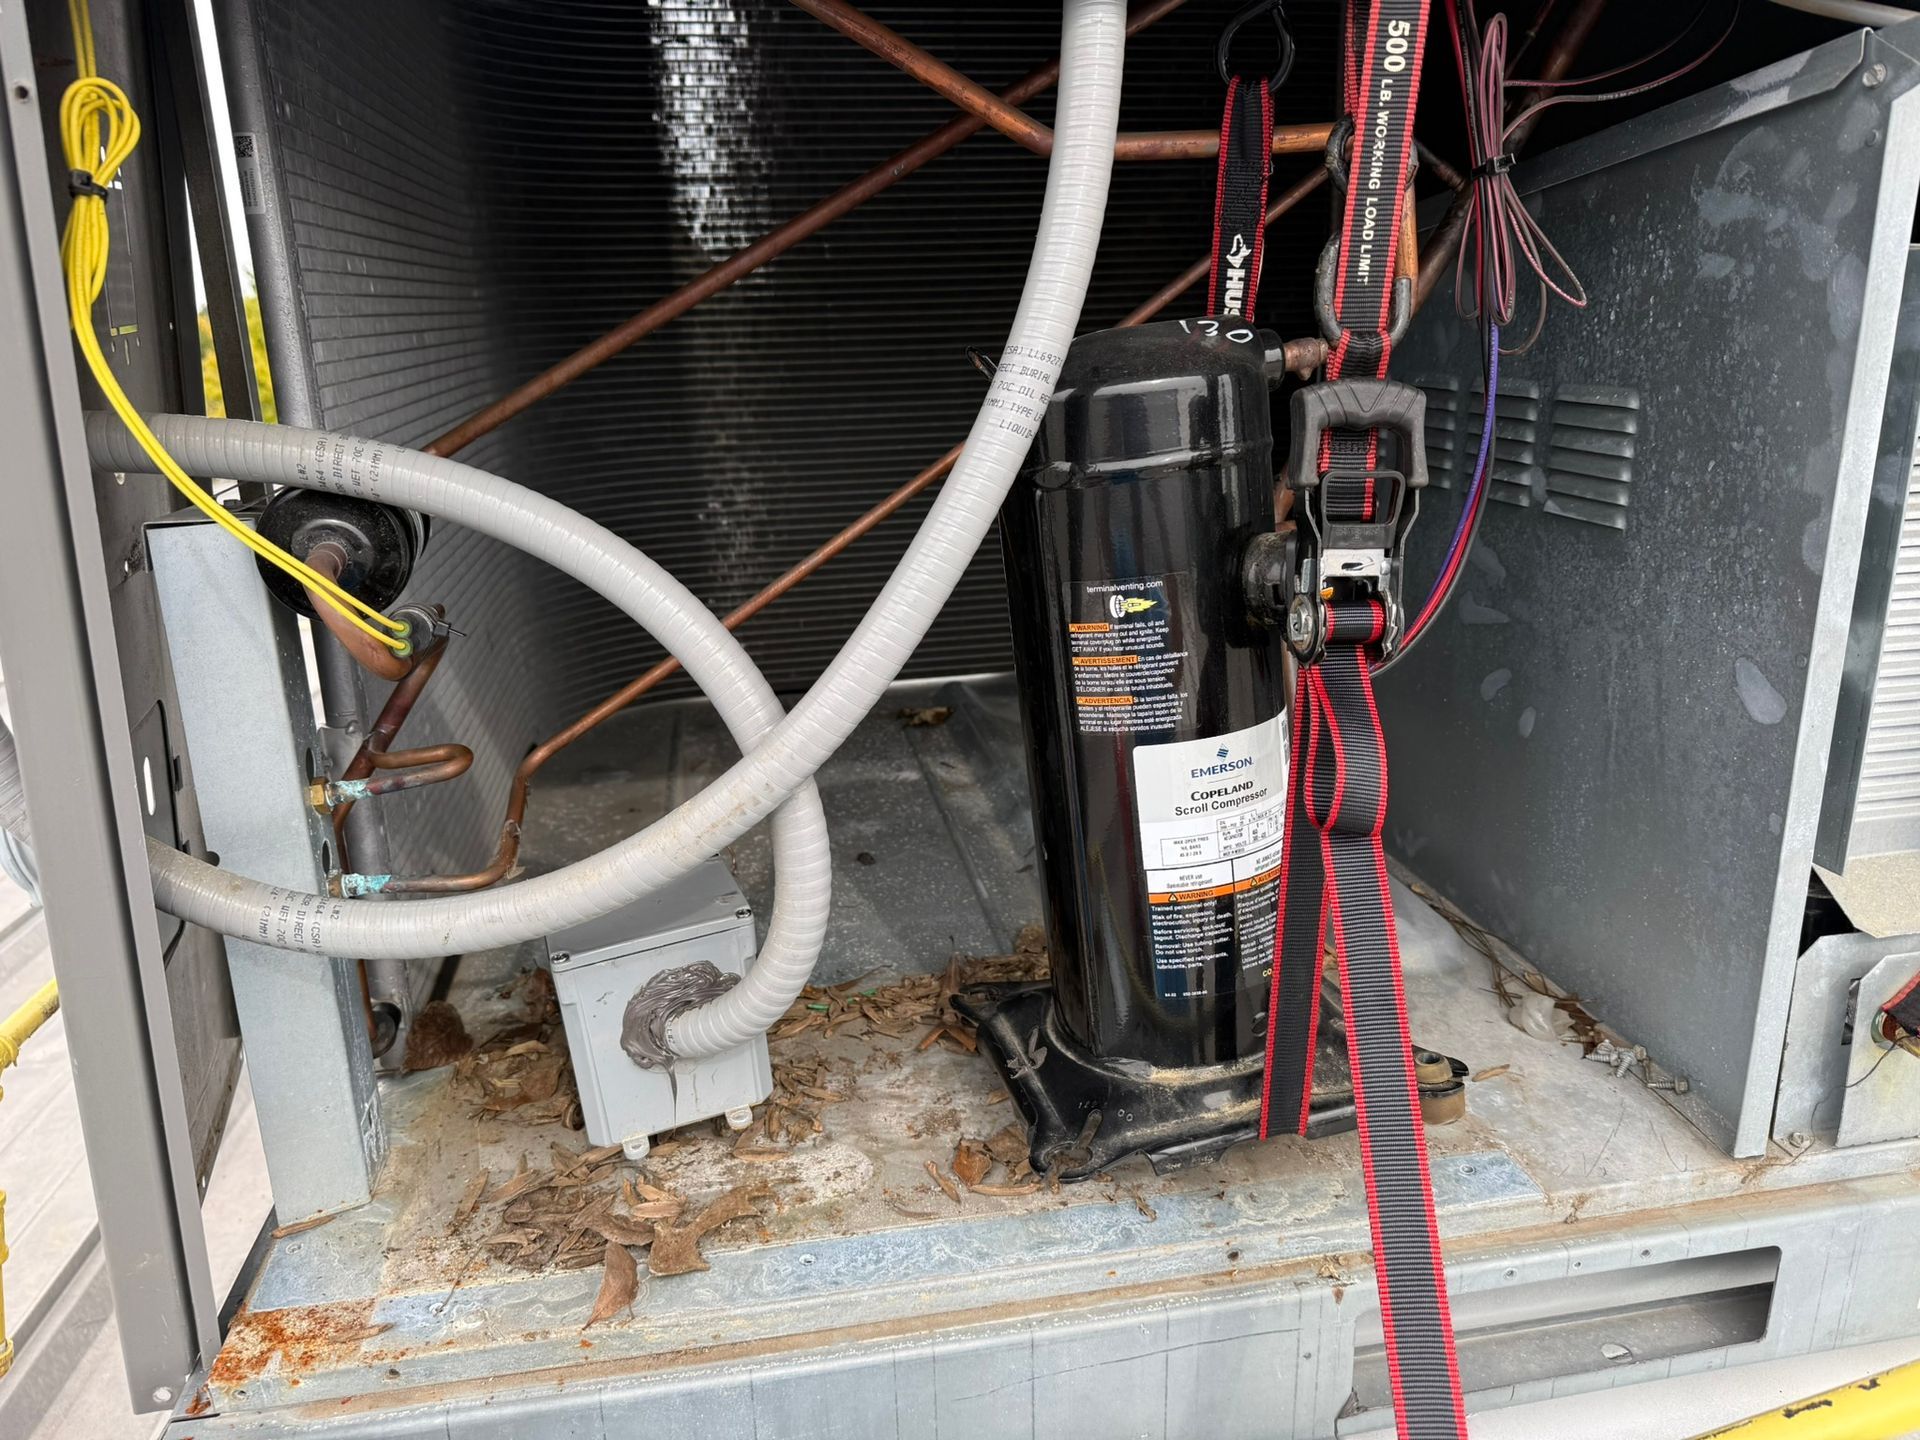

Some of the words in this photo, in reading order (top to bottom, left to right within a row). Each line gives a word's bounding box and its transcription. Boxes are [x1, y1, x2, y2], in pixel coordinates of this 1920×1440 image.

[1383, 20, 1410, 72] 500
[1379, 79, 1393, 107] LB.
[1368, 110, 1389, 190] WORKING
[1363, 197, 1378, 241] LOAD
[1357, 243, 1372, 285] LIMIT
[1020, 366, 1052, 384] BURIAL
[1018, 386, 1035, 399] OIL
[1010, 402, 1033, 417] TYPE
[333, 443, 345, 478] DIRECT
[351, 470, 360, 486] WET
[1087, 580, 1163, 593] terminalventing.com
[1191, 756, 1252, 779] EMERSON
[1175, 803, 1208, 816] Scroll
[1211, 788, 1267, 811] Compressor
[1191, 781, 1253, 801] COPELAND
[1180, 890, 1213, 900] WARNING
[259, 905, 271, 938] (21MM)
[278, 905, 290, 923] WET
[294, 910, 306, 944] DIRECT
[311, 922, 322, 948] (CSA)
